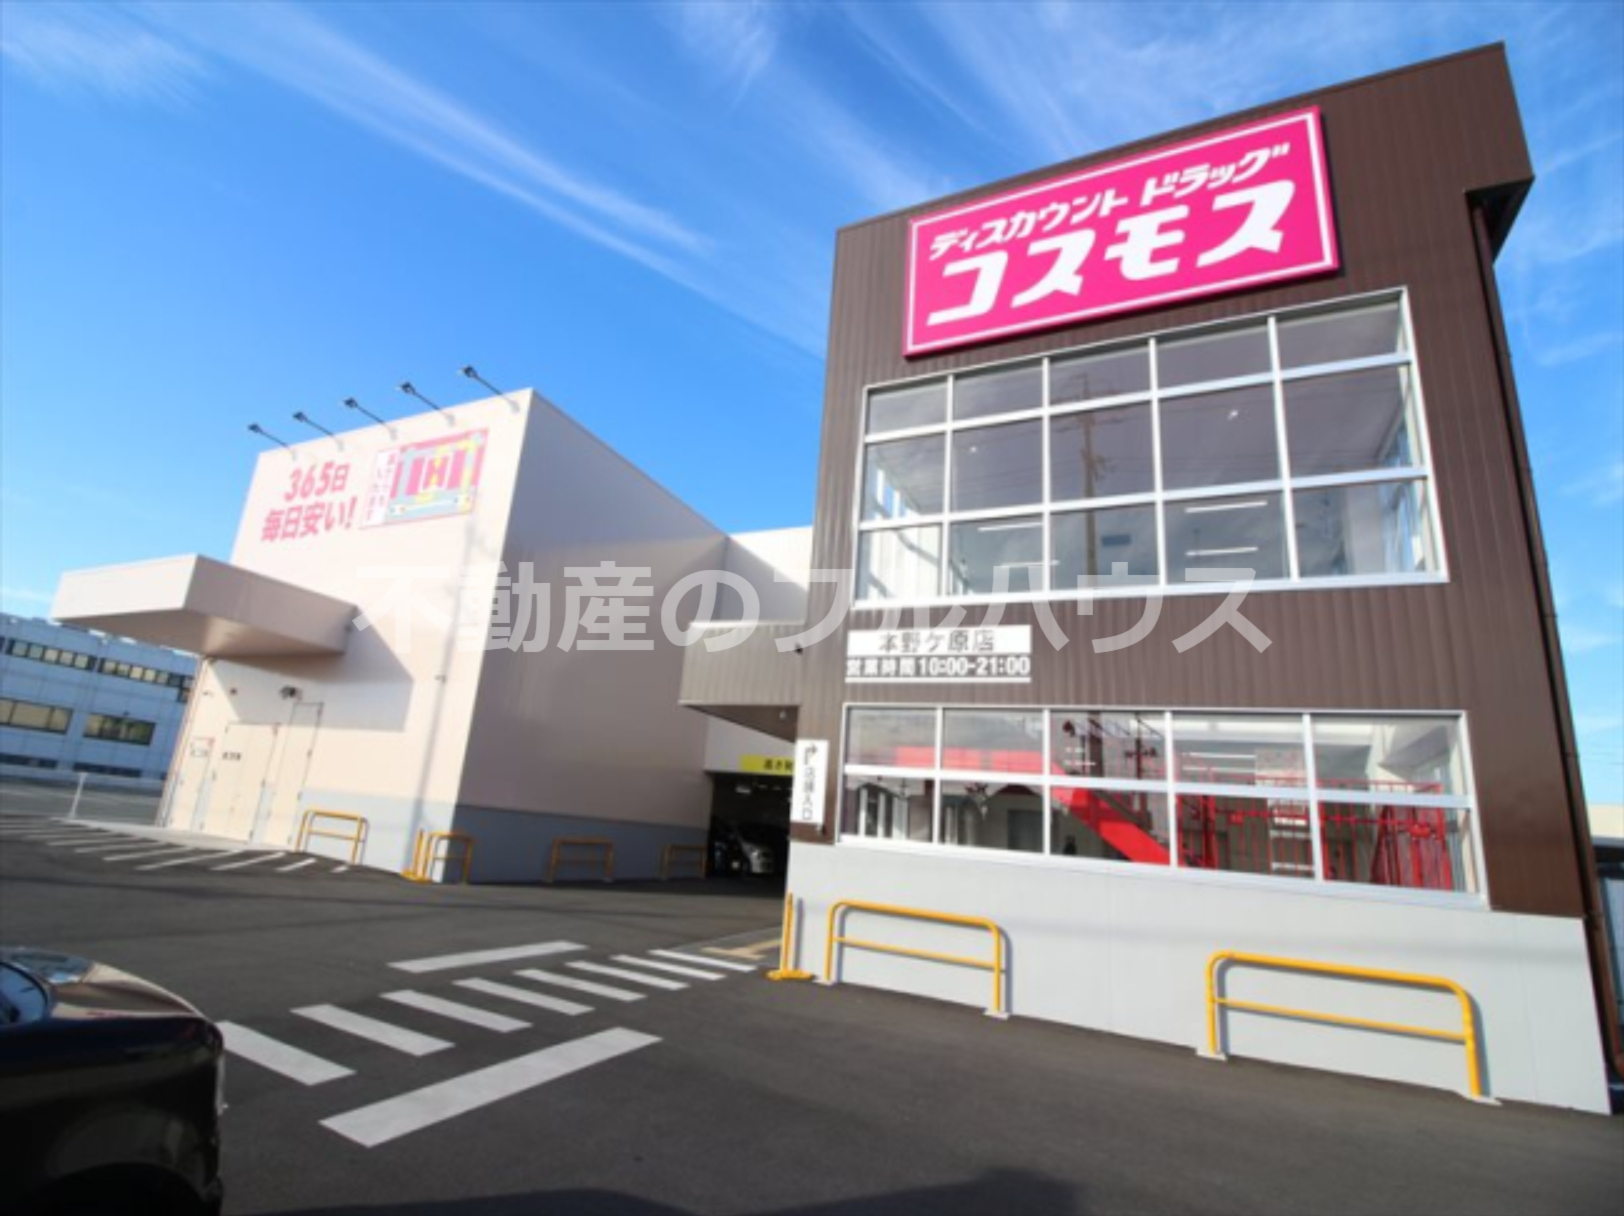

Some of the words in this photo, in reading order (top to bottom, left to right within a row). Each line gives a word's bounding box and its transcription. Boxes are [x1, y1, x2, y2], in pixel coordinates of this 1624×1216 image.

[926, 179, 1295, 326] コスモス
[929, 188, 1128, 260] ディスカウント
[1140, 142, 1290, 206] ドラッグ
[284, 461, 351, 501] 365日
